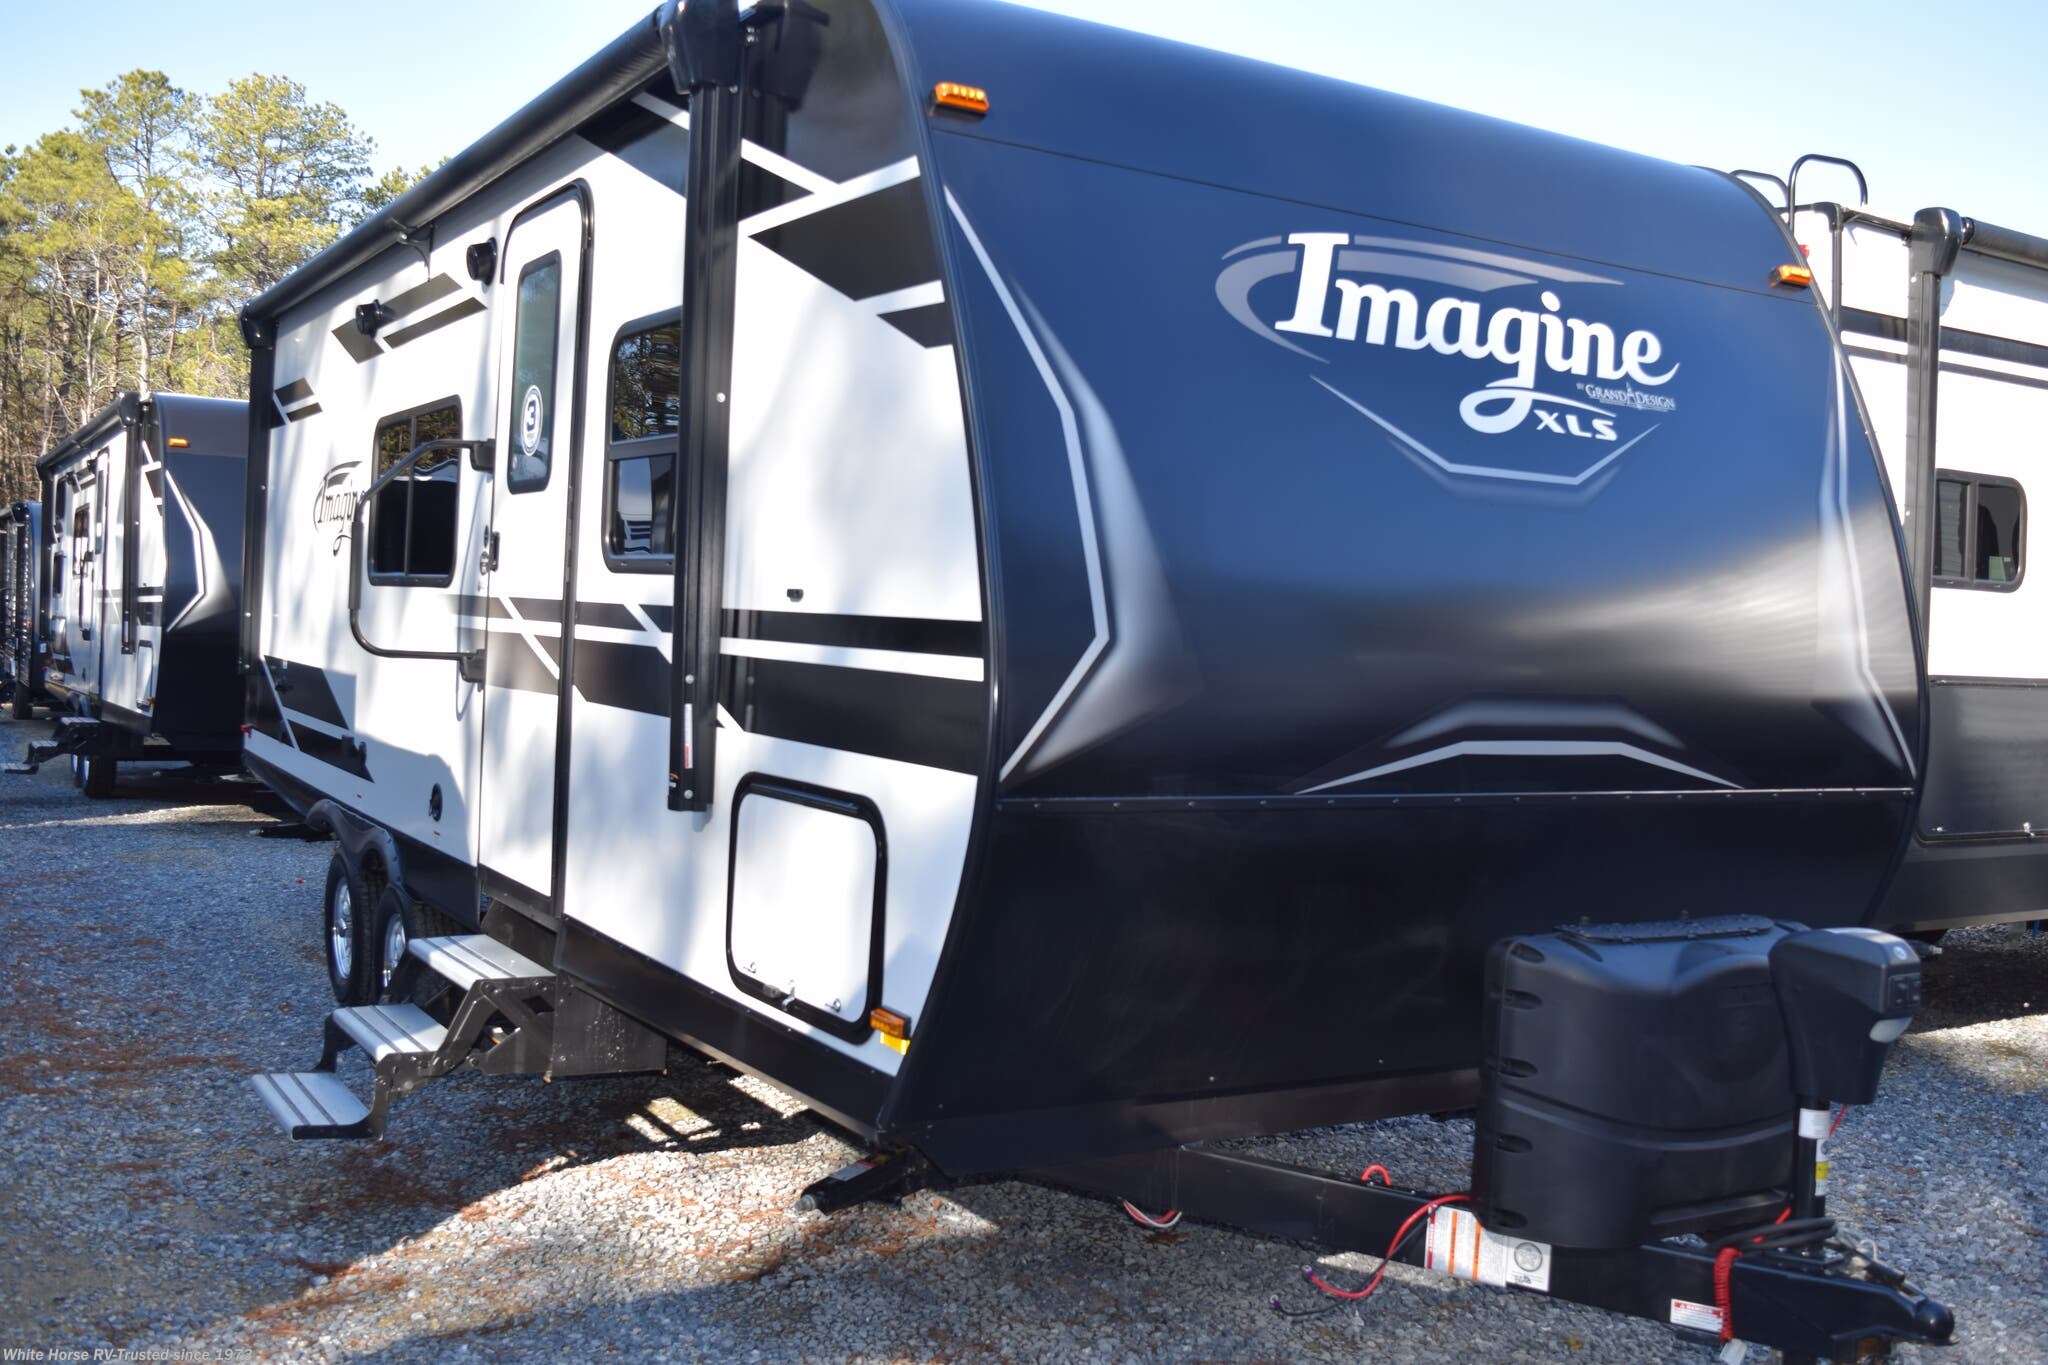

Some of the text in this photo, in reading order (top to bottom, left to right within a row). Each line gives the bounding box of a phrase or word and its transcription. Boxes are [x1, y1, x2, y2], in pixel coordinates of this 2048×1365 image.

[1274, 232, 1681, 434] Imagine
[526, 399, 537, 431] 3
[1533, 409, 1618, 442] XLS
